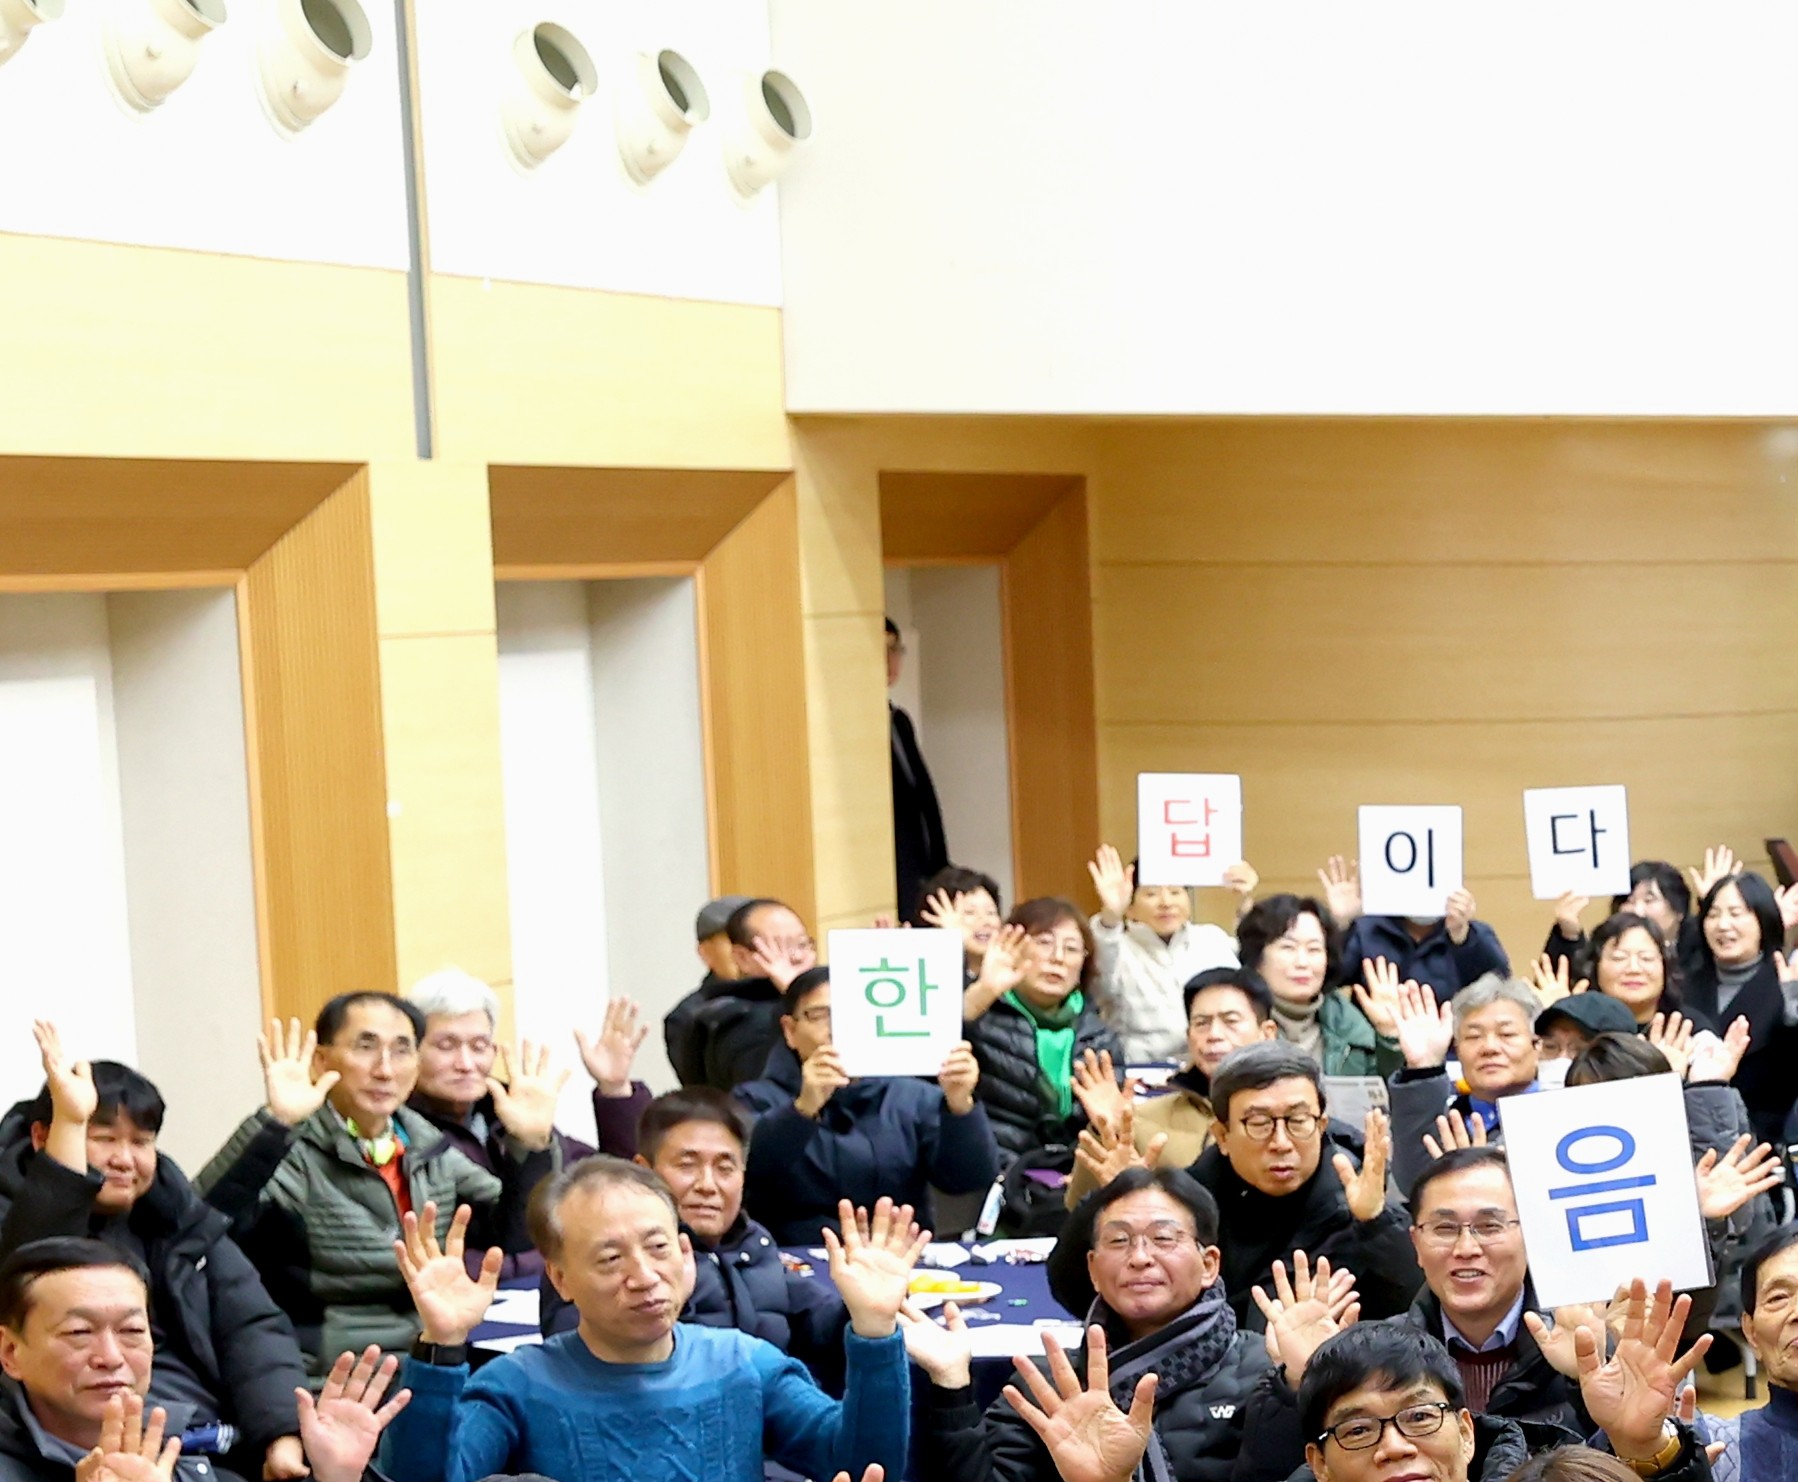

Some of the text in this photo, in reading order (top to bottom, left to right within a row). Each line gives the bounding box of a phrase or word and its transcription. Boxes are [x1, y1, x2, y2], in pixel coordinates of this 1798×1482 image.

[1163, 798, 1218, 858] 답
[1384, 828, 1435, 888] 이
[1550, 808, 1606, 870] 다
[859, 957, 939, 1038] 한
[1548, 1124, 1657, 1253] 음
